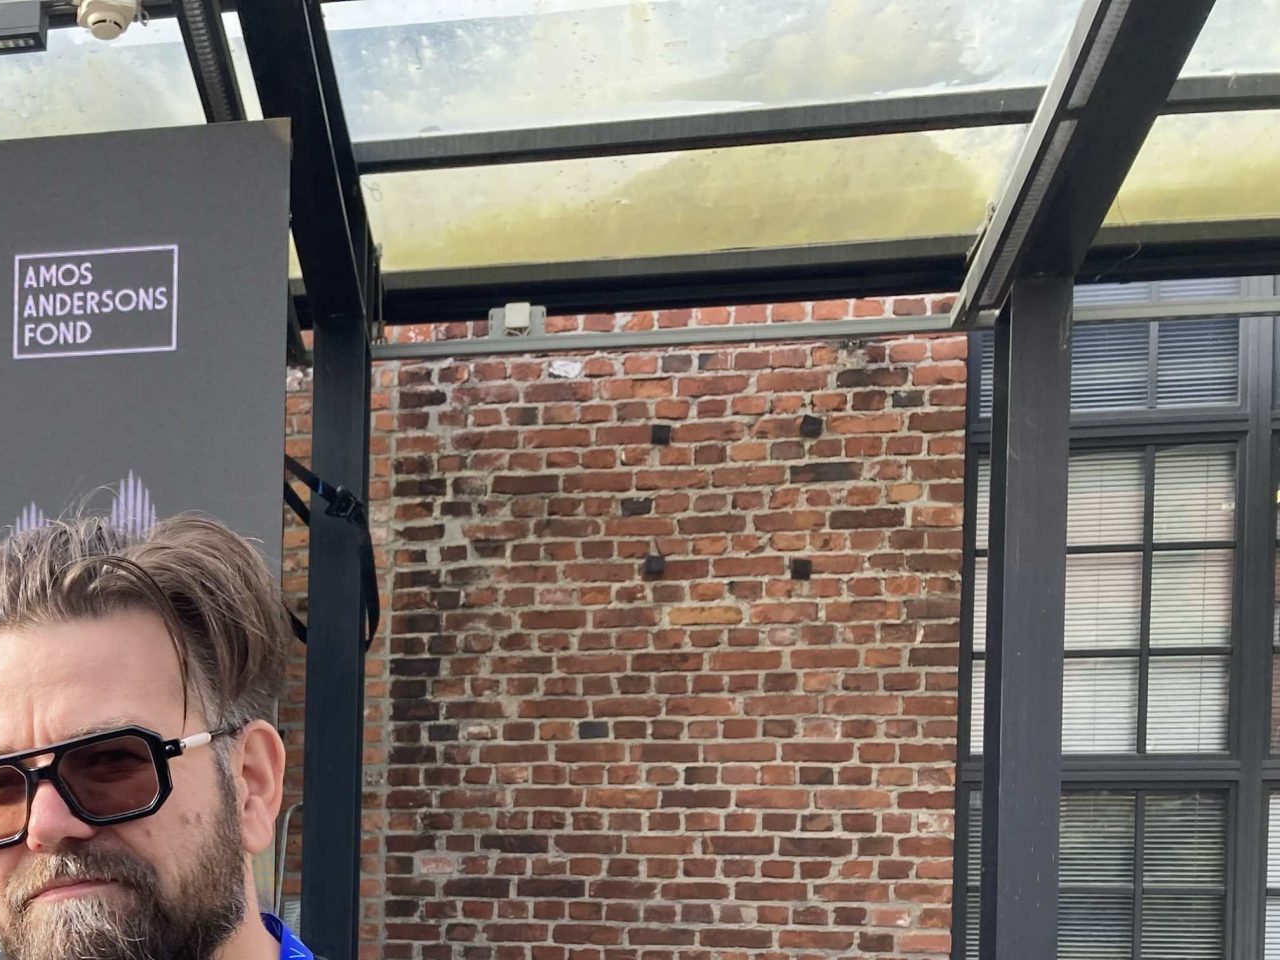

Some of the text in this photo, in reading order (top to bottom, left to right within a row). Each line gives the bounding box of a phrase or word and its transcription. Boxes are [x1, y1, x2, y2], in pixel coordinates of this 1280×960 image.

[23, 263, 93, 289] AMOS
[23, 287, 168, 318] ANDERSONS
[24, 323, 92, 347] FOND
